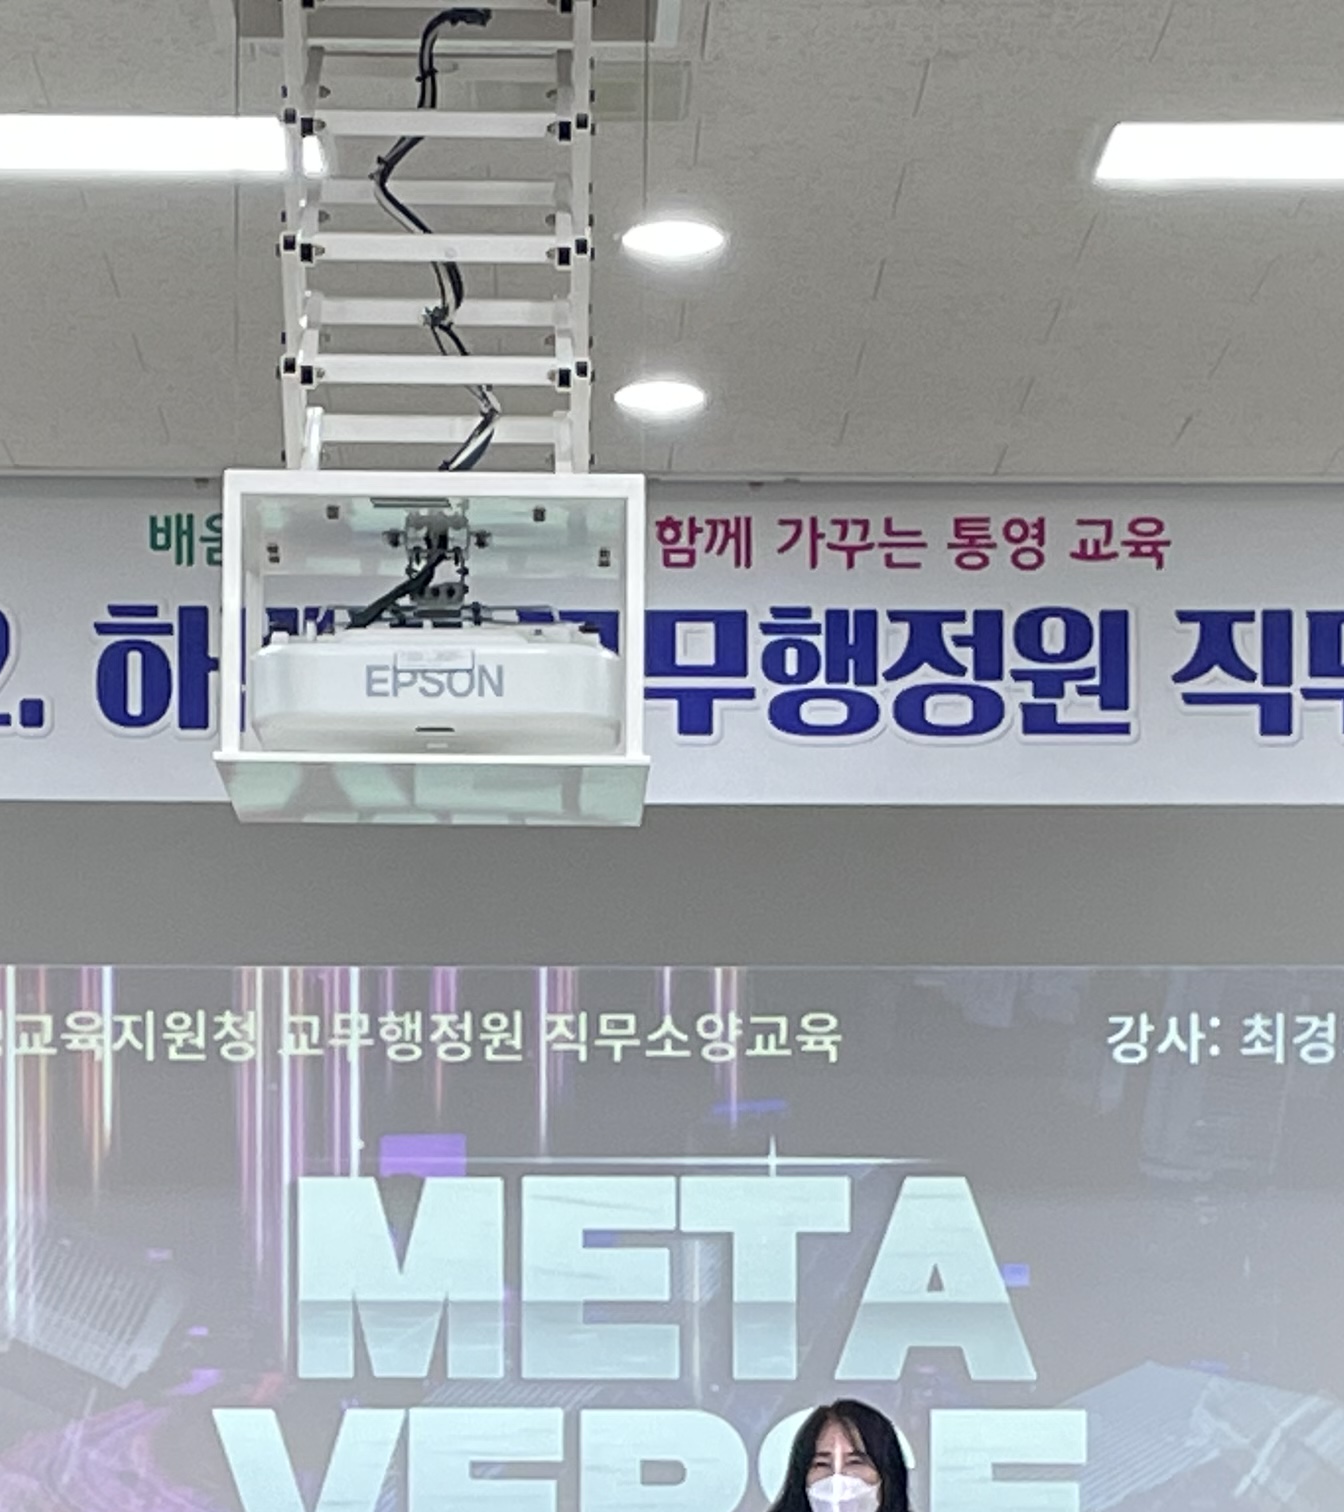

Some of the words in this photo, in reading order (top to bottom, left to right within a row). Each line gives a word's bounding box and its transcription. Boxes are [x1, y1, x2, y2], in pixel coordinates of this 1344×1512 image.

[655, 515, 753, 569] 함께
[776, 515, 928, 570] 가꾸는
[946, 515, 1047, 571] 통영
[1069, 515, 1172, 570] 교육
[365, 664, 505, 698] EPSON
[517, 604, 1133, 738] 무행정원
[277, 1010, 524, 1063] 교무행정원
[545, 1010, 843, 1064] 직무소양교육
[1106, 1011, 1221, 1065] 강사:
[297, 1175, 1039, 1381] META
